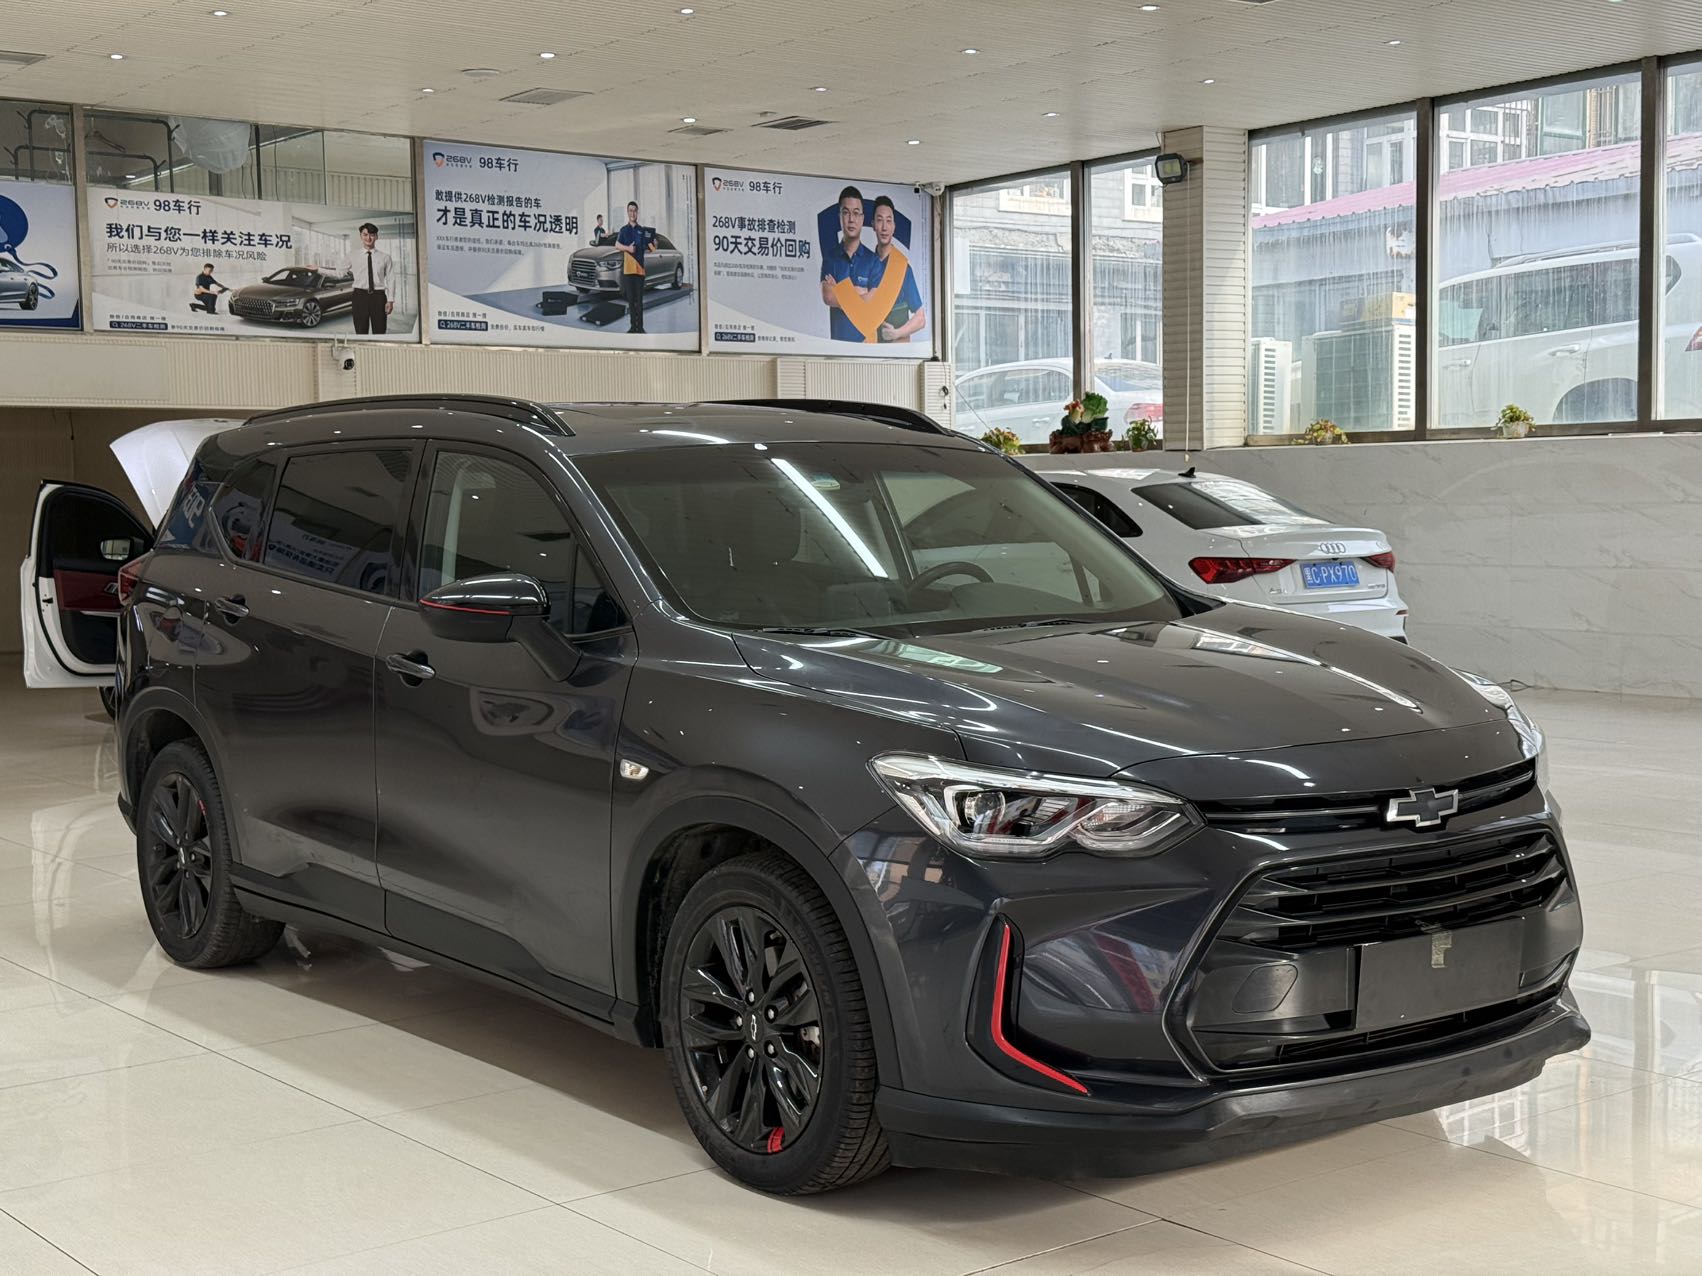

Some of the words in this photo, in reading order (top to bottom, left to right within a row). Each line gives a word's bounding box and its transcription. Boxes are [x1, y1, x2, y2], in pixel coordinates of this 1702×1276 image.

[446, 155, 472, 164] 268V
[479, 157, 519, 173] 98车行
[749, 181, 783, 195] 98车行
[153, 199, 202, 215] 98车行
[435, 189, 542, 209] 敢提供268V检测报告的车
[436, 206, 579, 236] 才是真正的车况透明
[712, 215, 796, 235] 268V事故排查检测
[106, 222, 293, 250] 我们与您一样关注车况
[106, 242, 268, 262] 所以选择268V为您排除车况风险
[713, 235, 811, 260] 90天交易价回购
